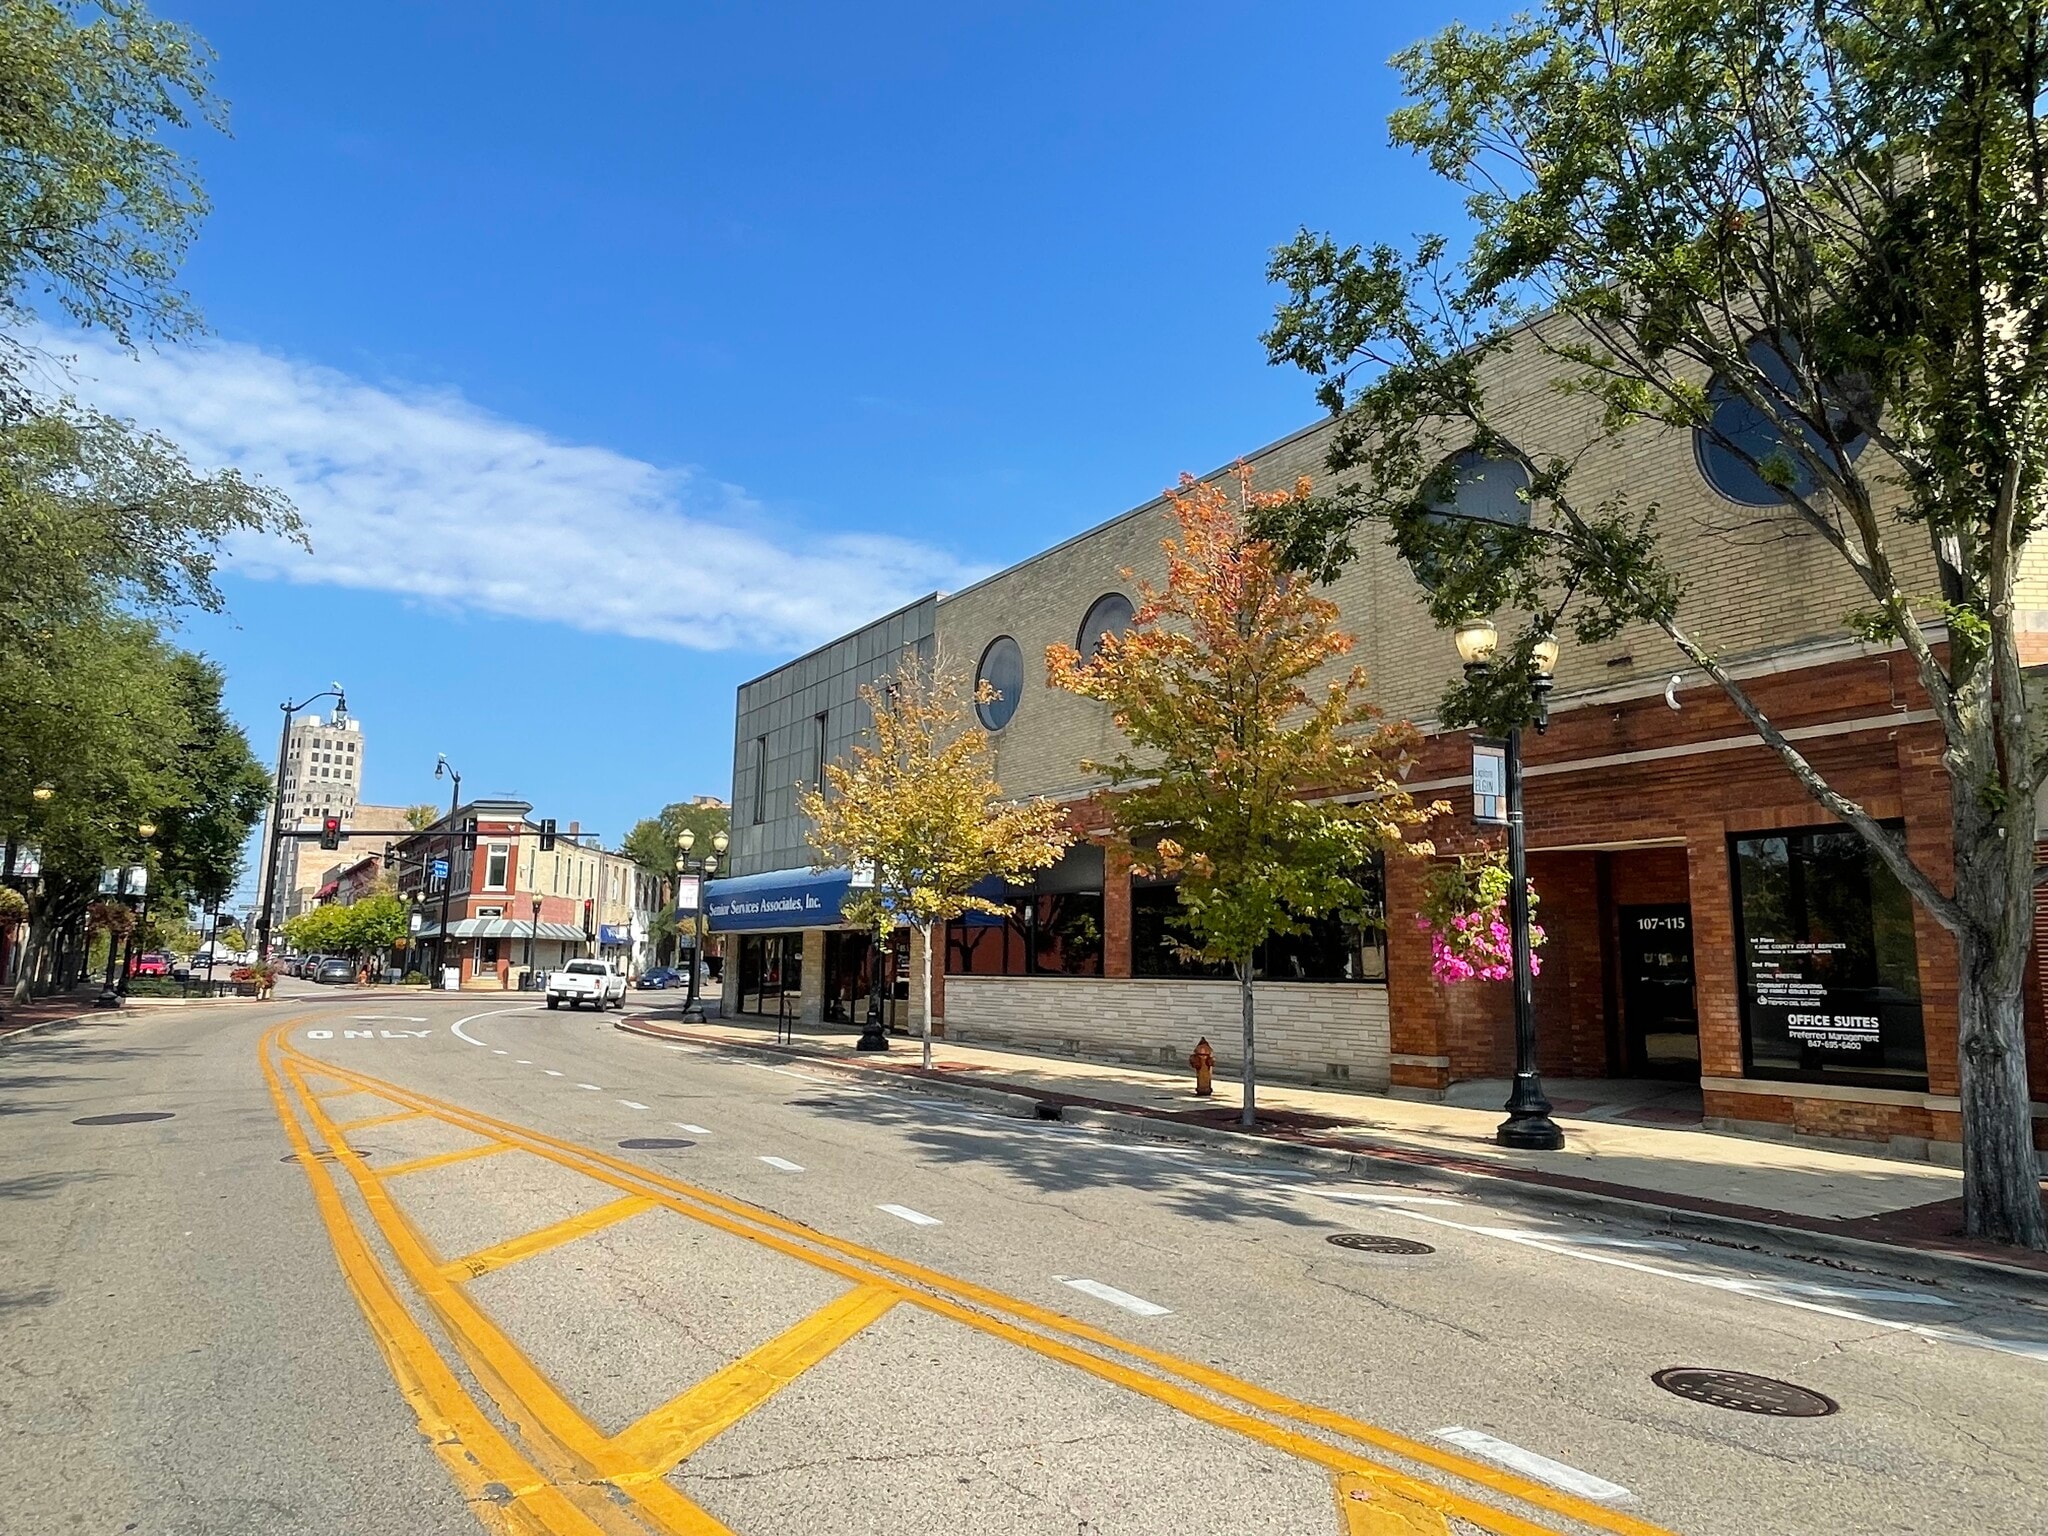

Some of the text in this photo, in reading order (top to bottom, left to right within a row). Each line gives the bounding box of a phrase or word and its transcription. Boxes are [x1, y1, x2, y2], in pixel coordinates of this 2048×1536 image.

[1475, 779, 1494, 793] ELGIN
[709, 893, 821, 917] Senior Services Associates, Inc.
[1636, 917, 1686, 930] 107-115
[1787, 1014, 1880, 1028] OFFICE SUITES
[306, 1029, 432, 1040] ONLY
[1789, 1030, 1880, 1043] Preferred Management
